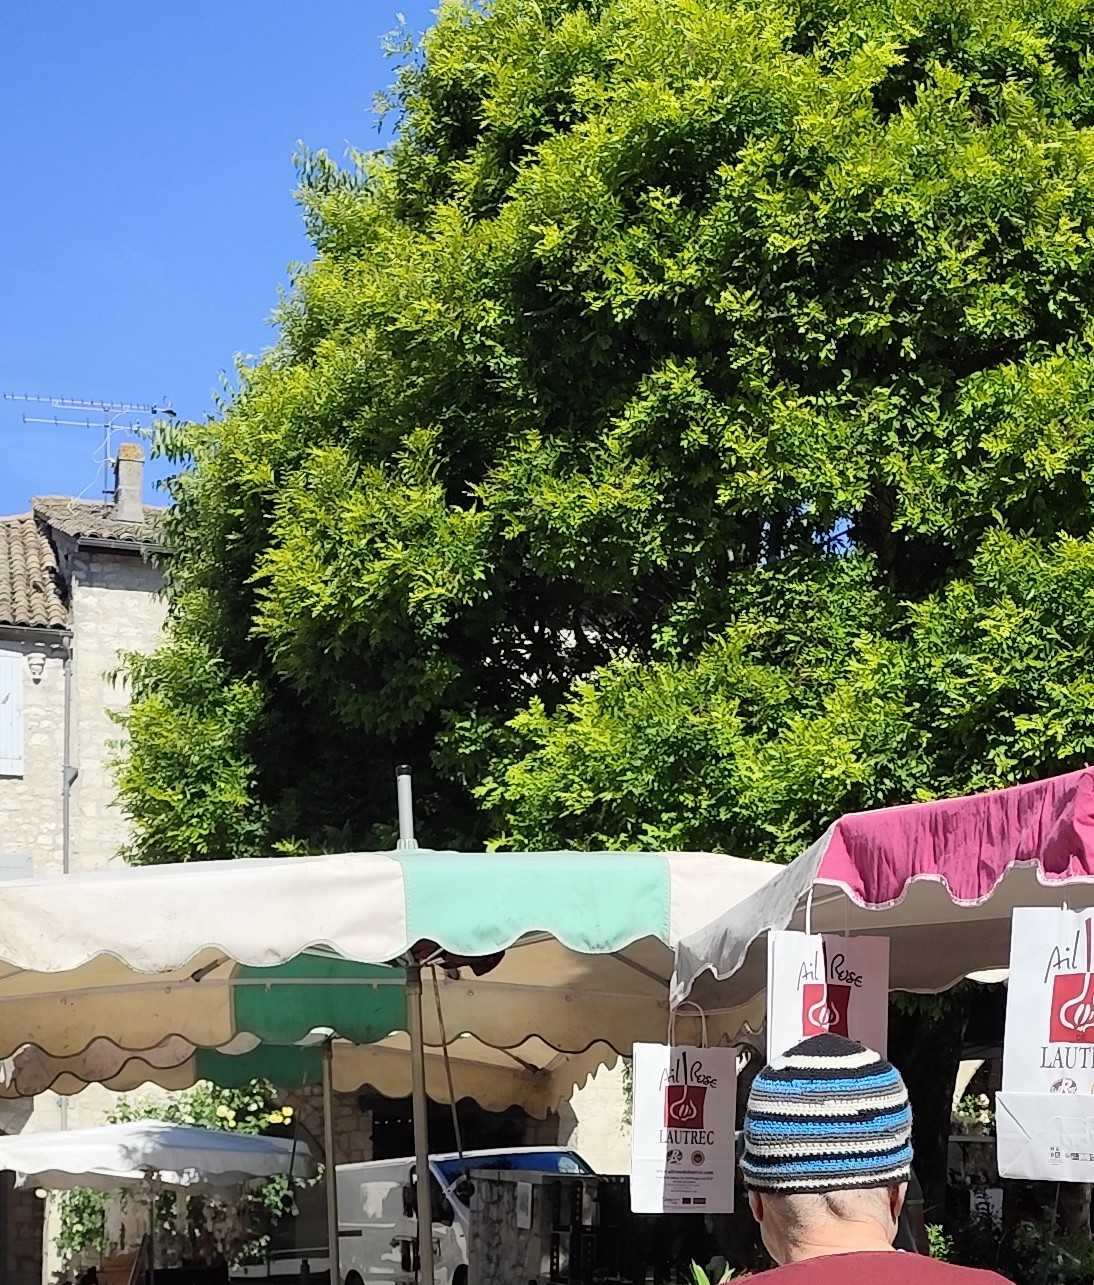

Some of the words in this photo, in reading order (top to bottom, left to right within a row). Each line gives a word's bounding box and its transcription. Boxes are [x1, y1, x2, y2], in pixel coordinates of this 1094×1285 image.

[796, 951, 819, 991] Ail
[830, 953, 863, 987] Rose
[1044, 930, 1080, 984] Ail
[659, 1058, 681, 1091] Ail
[690, 1061, 718, 1089] Rose
[659, 1129, 715, 1145] LAUTREC
